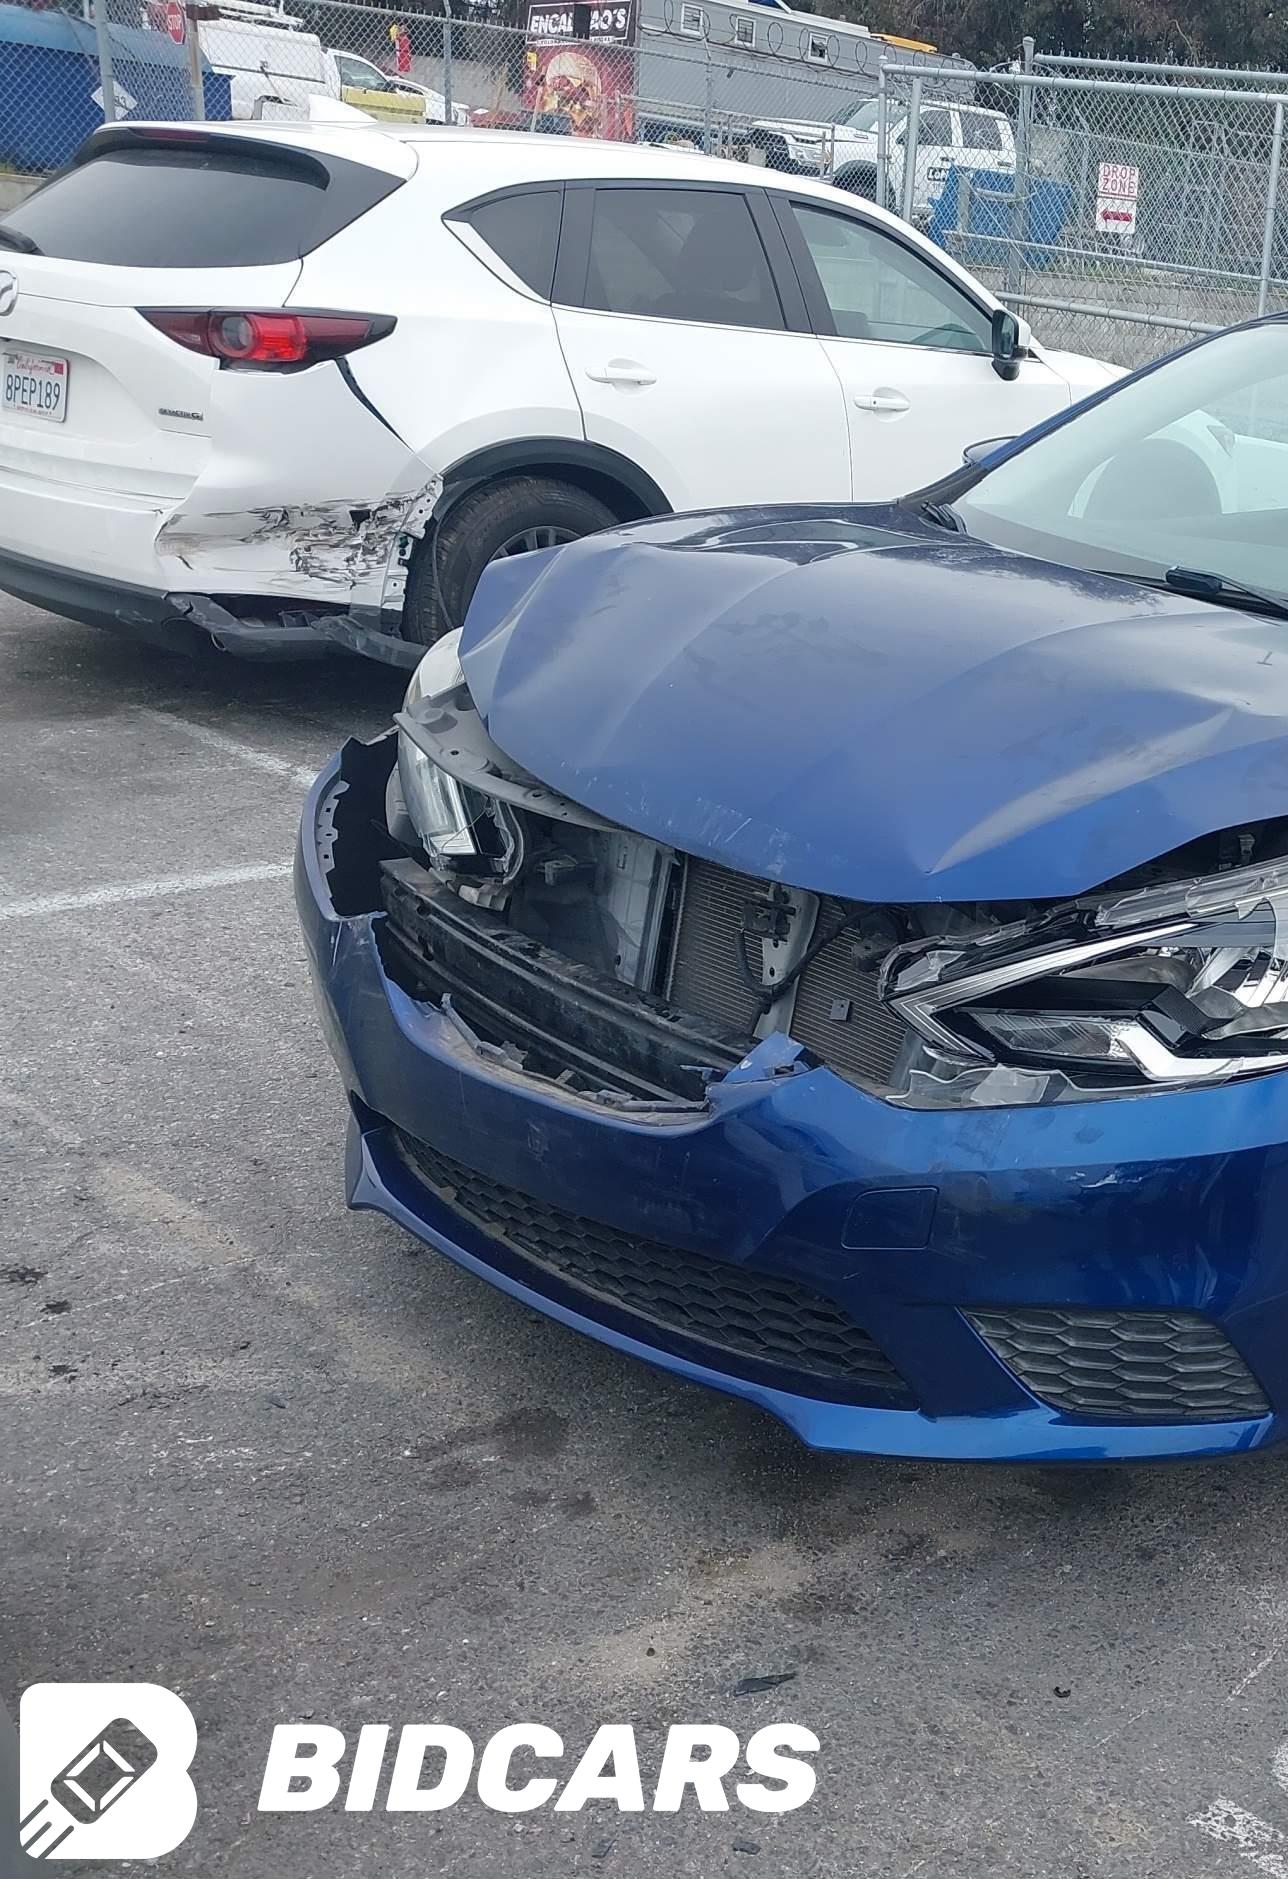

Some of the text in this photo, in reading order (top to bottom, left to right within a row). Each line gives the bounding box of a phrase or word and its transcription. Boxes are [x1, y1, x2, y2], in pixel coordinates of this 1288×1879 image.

[1102, 164, 1136, 180] DROP
[1102, 177, 1136, 194] ZONE
[5, 374, 61, 411] 8PEP189
